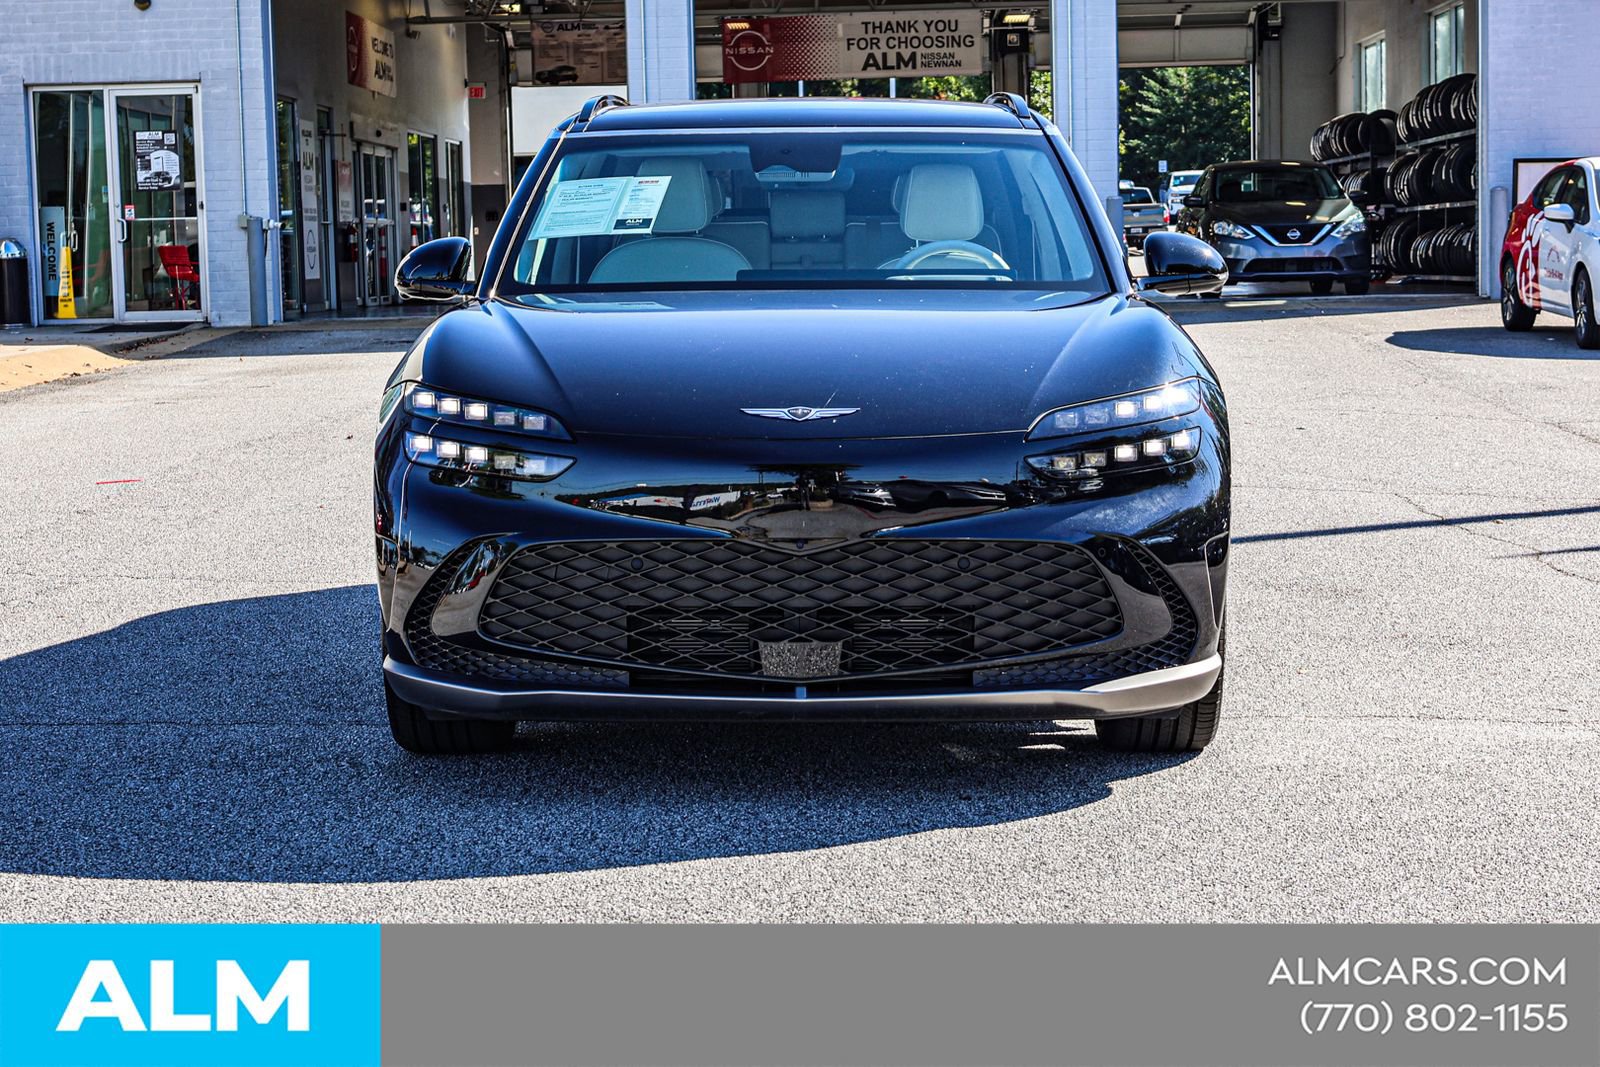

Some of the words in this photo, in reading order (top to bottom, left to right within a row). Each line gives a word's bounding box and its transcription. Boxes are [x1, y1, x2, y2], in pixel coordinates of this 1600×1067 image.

[556, 23, 581, 32] ALM
[861, 20, 918, 35] THANK
[922, 19, 959, 33] YOU
[725, 46, 774, 55] NISSAN
[846, 37, 880, 51] FOR
[886, 34, 975, 51] CHOOSING
[861, 51, 917, 71] ALM
[920, 59, 962, 68] NEWNAN
[46, 222, 57, 281] WELCOME
